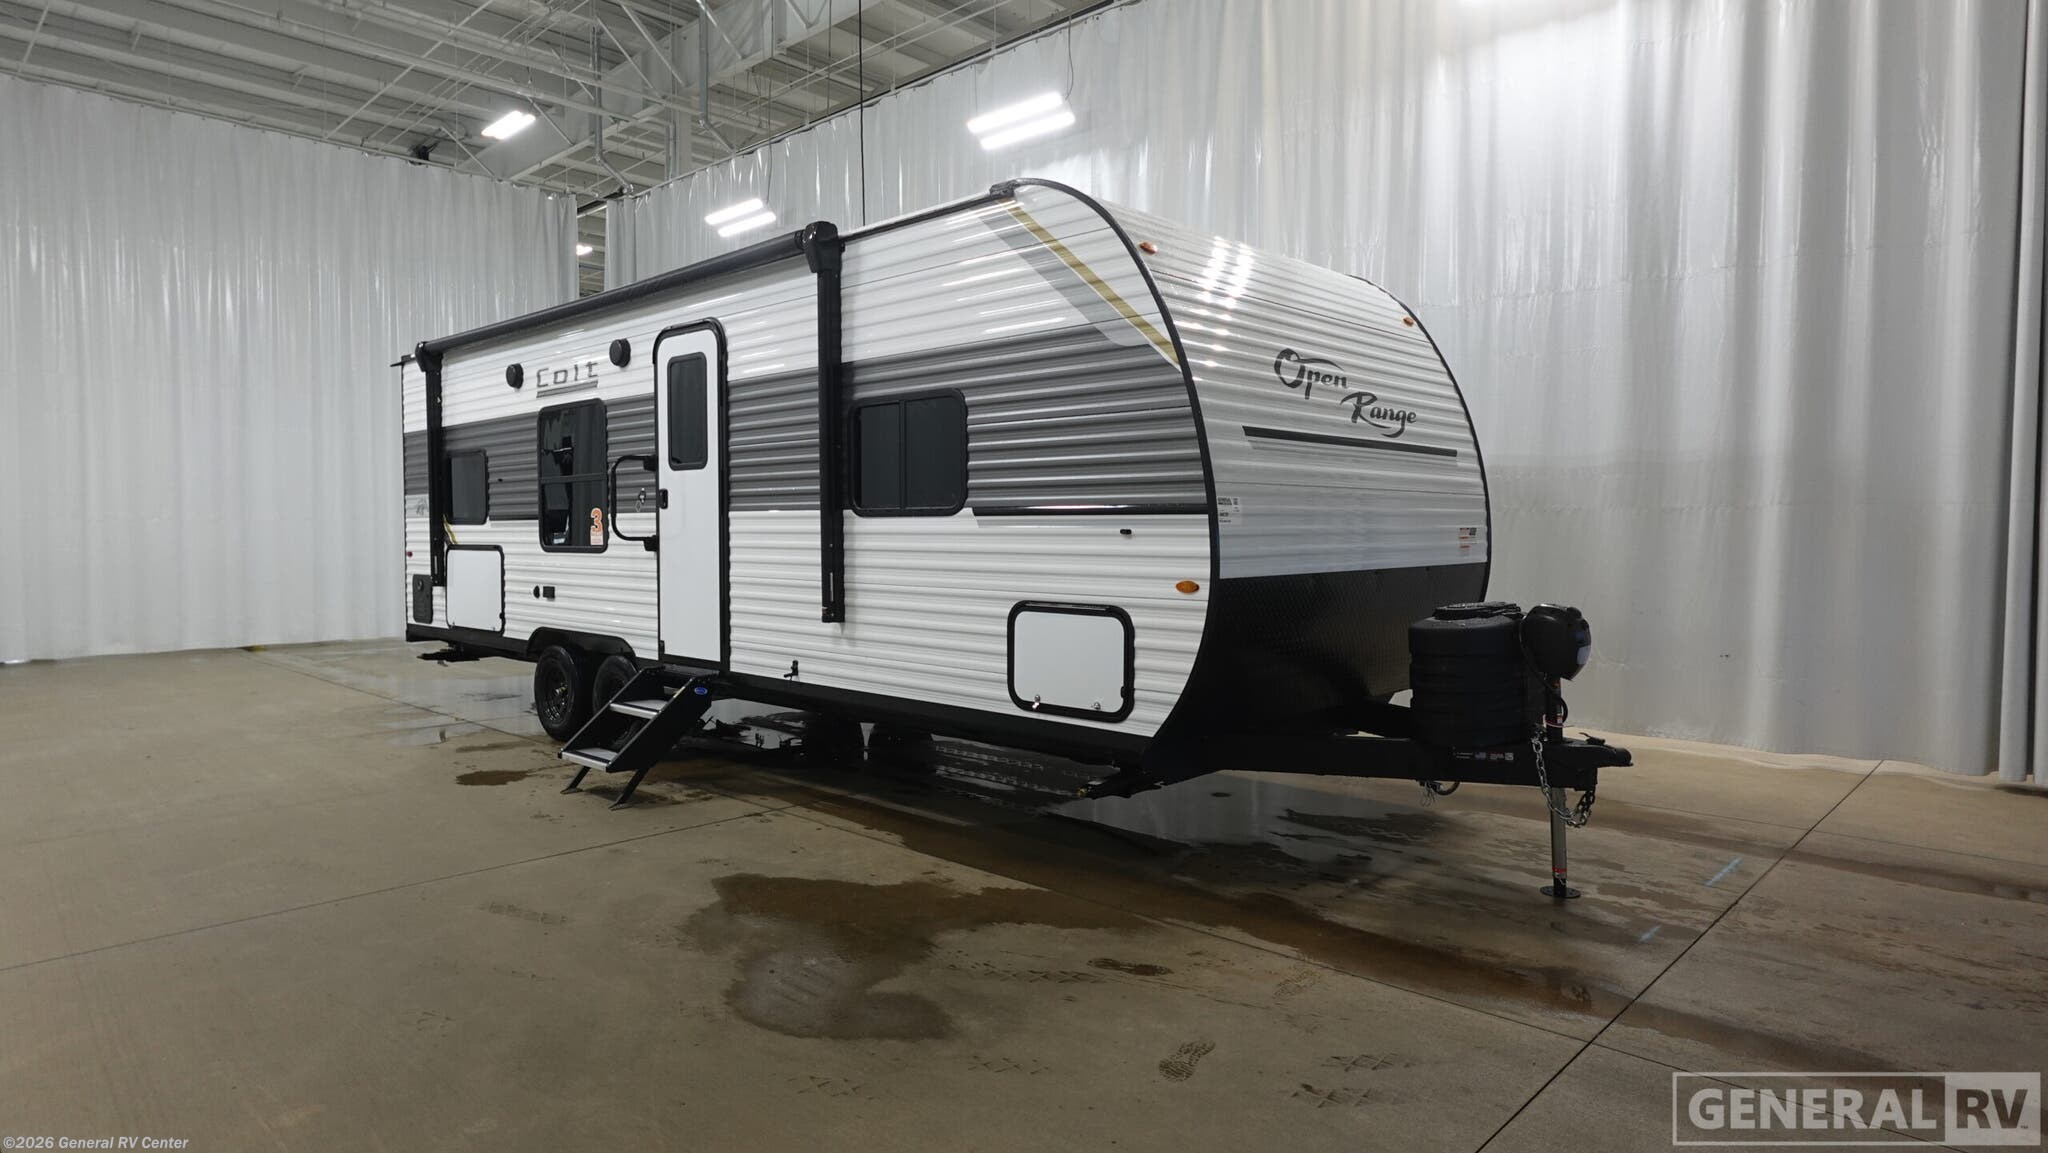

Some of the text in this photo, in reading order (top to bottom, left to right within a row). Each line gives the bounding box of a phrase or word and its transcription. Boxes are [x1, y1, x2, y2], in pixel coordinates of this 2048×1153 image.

[537, 361, 598, 388] Colt
[1274, 348, 1348, 400] Open
[1339, 391, 1417, 438] Range
[591, 508, 603, 533] 3
